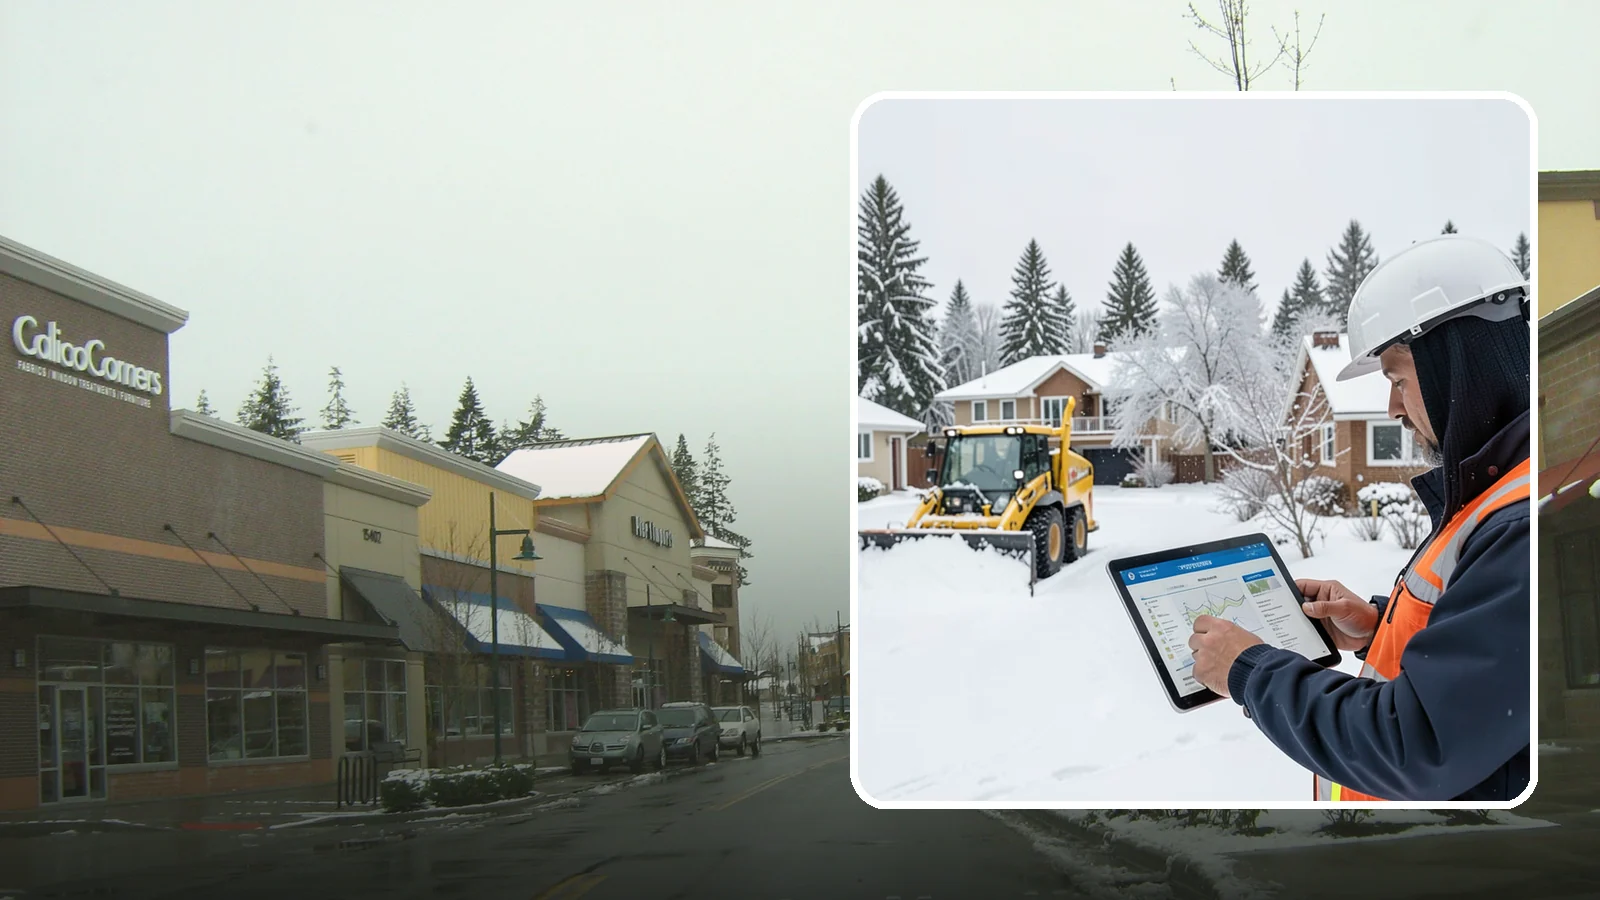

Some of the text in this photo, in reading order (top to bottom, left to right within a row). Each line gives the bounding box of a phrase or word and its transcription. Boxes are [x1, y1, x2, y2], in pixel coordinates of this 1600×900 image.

[13, 315, 162, 395] CalicoCorners
[17, 360, 47, 377] FABRICS
[51, 370, 78, 387] WINDOW
[79, 378, 117, 398] TREATMENTS
